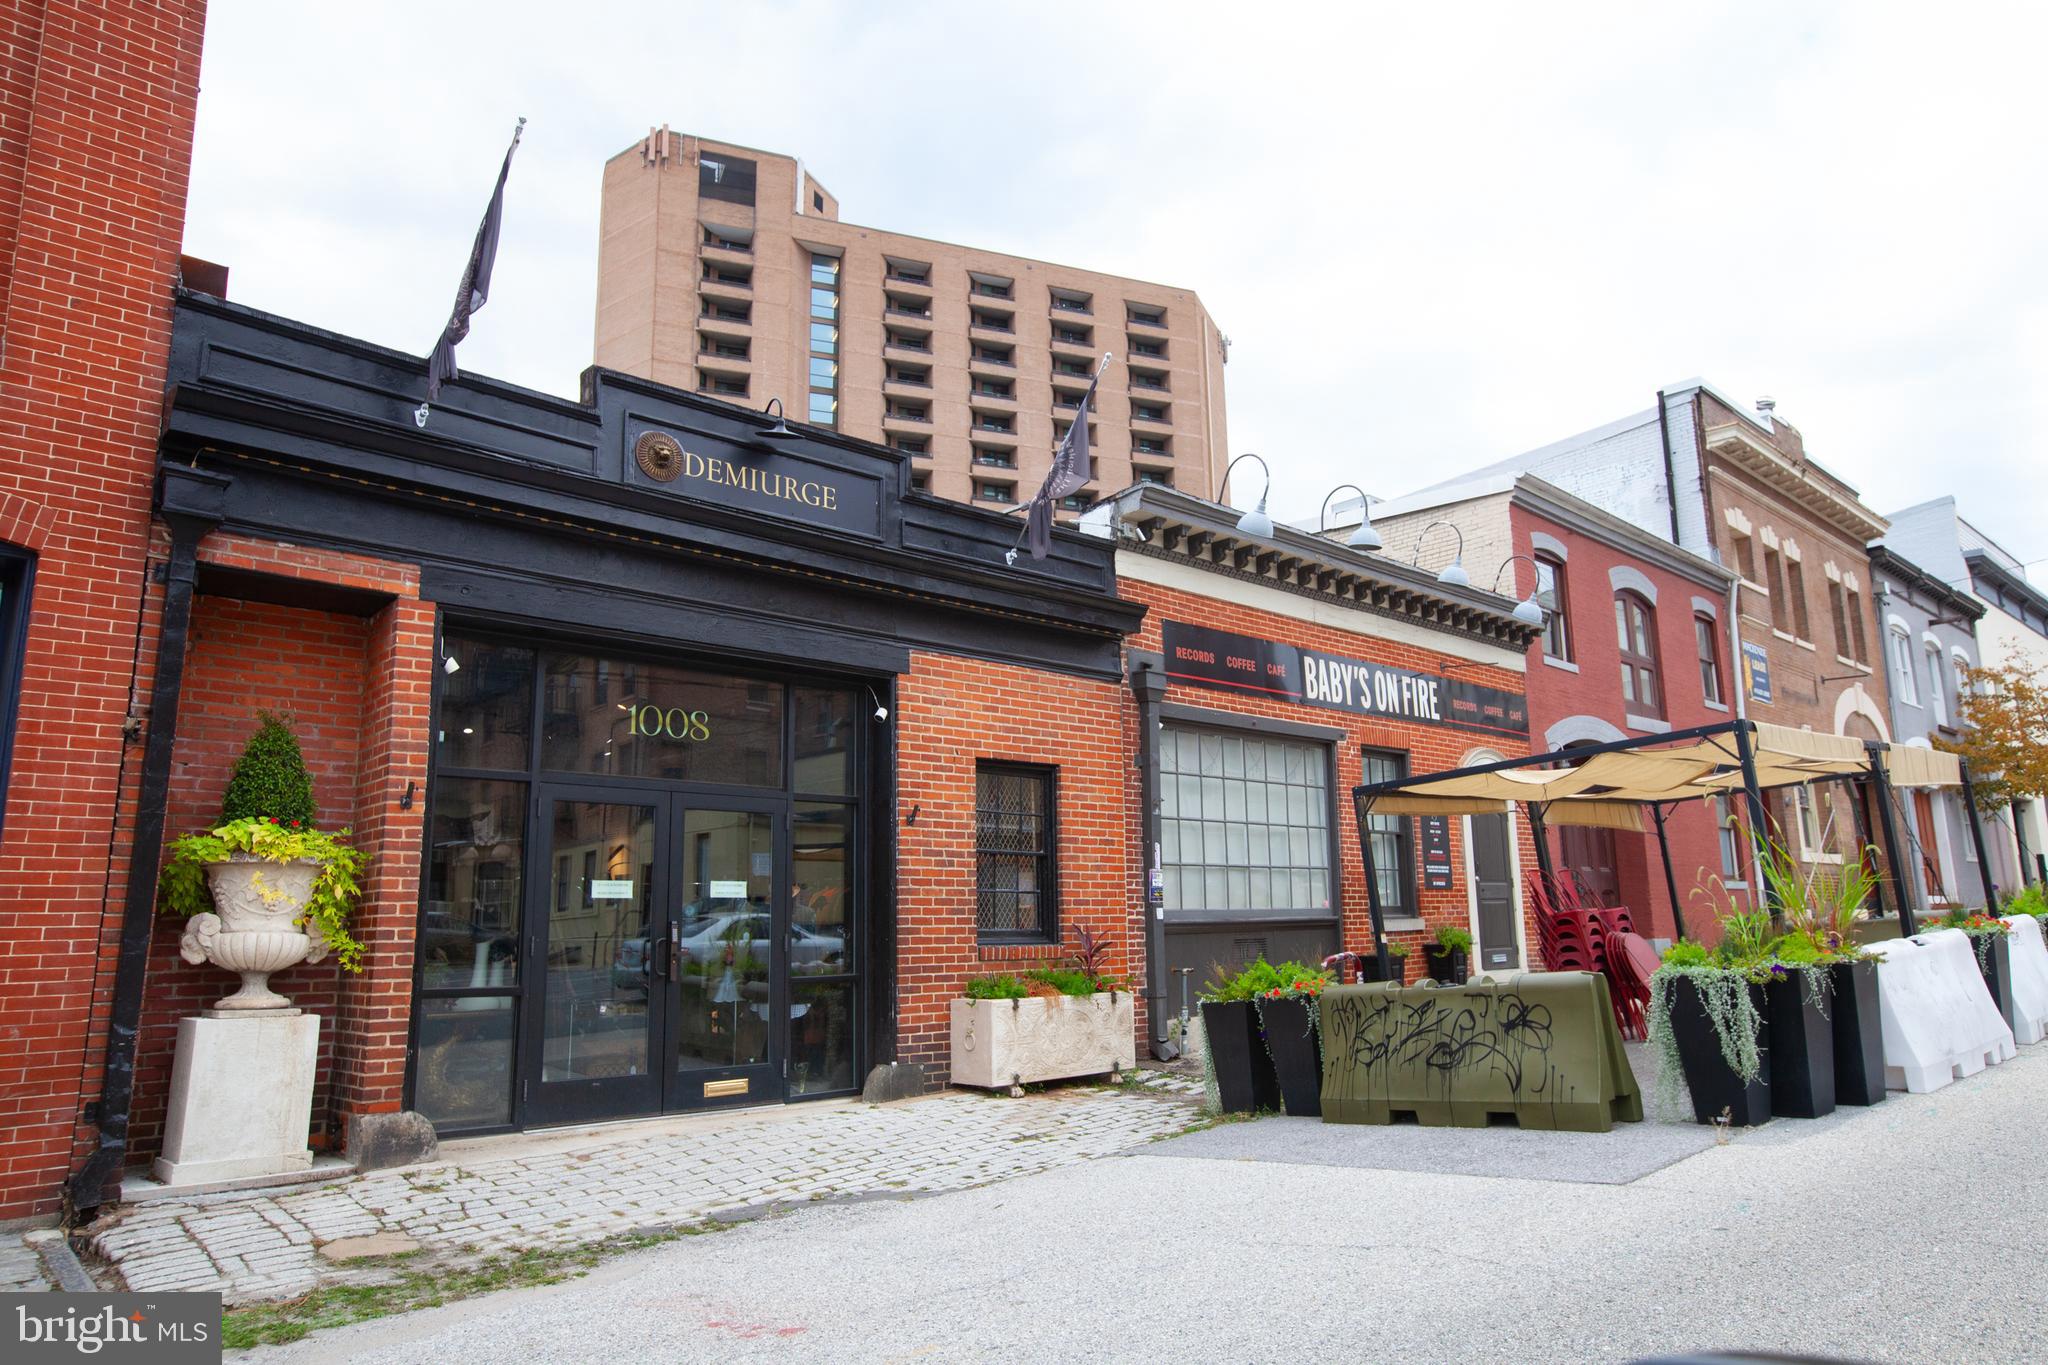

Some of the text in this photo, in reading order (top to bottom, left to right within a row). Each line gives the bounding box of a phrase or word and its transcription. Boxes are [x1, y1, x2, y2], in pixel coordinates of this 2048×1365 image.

[684, 452, 837, 511] DEMIURGE
[1175, 646, 1287, 677] RECORDS COFFEE CAFÉ
[1303, 655, 1441, 721] BABY'S ON FIRE
[627, 704, 710, 741] 1008
[1452, 698, 1477, 713] RECORDS
[1483, 704, 1504, 718] COFFEE
